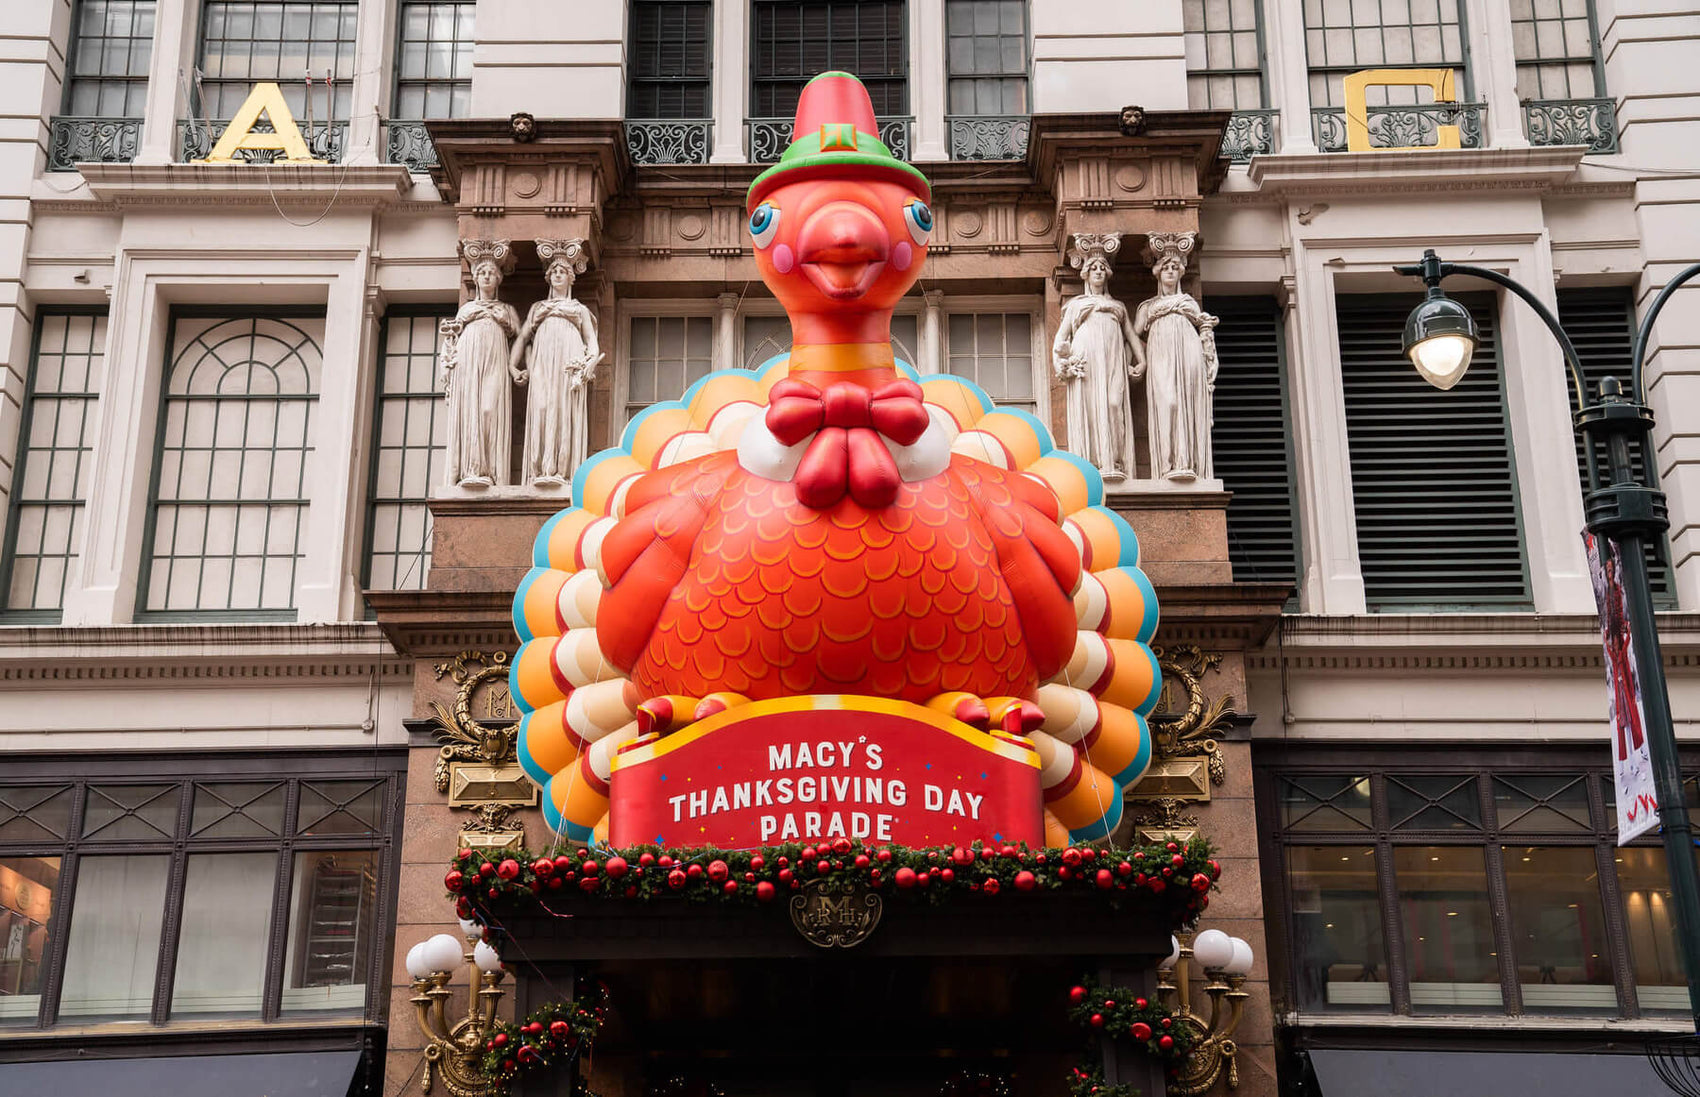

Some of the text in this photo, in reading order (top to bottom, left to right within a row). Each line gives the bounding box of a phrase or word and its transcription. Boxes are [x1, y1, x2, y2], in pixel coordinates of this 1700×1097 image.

[189, 82, 328, 165] A
[768, 735, 883, 771] MACY'S
[668, 776, 983, 822] THANKSGIVING DAY
